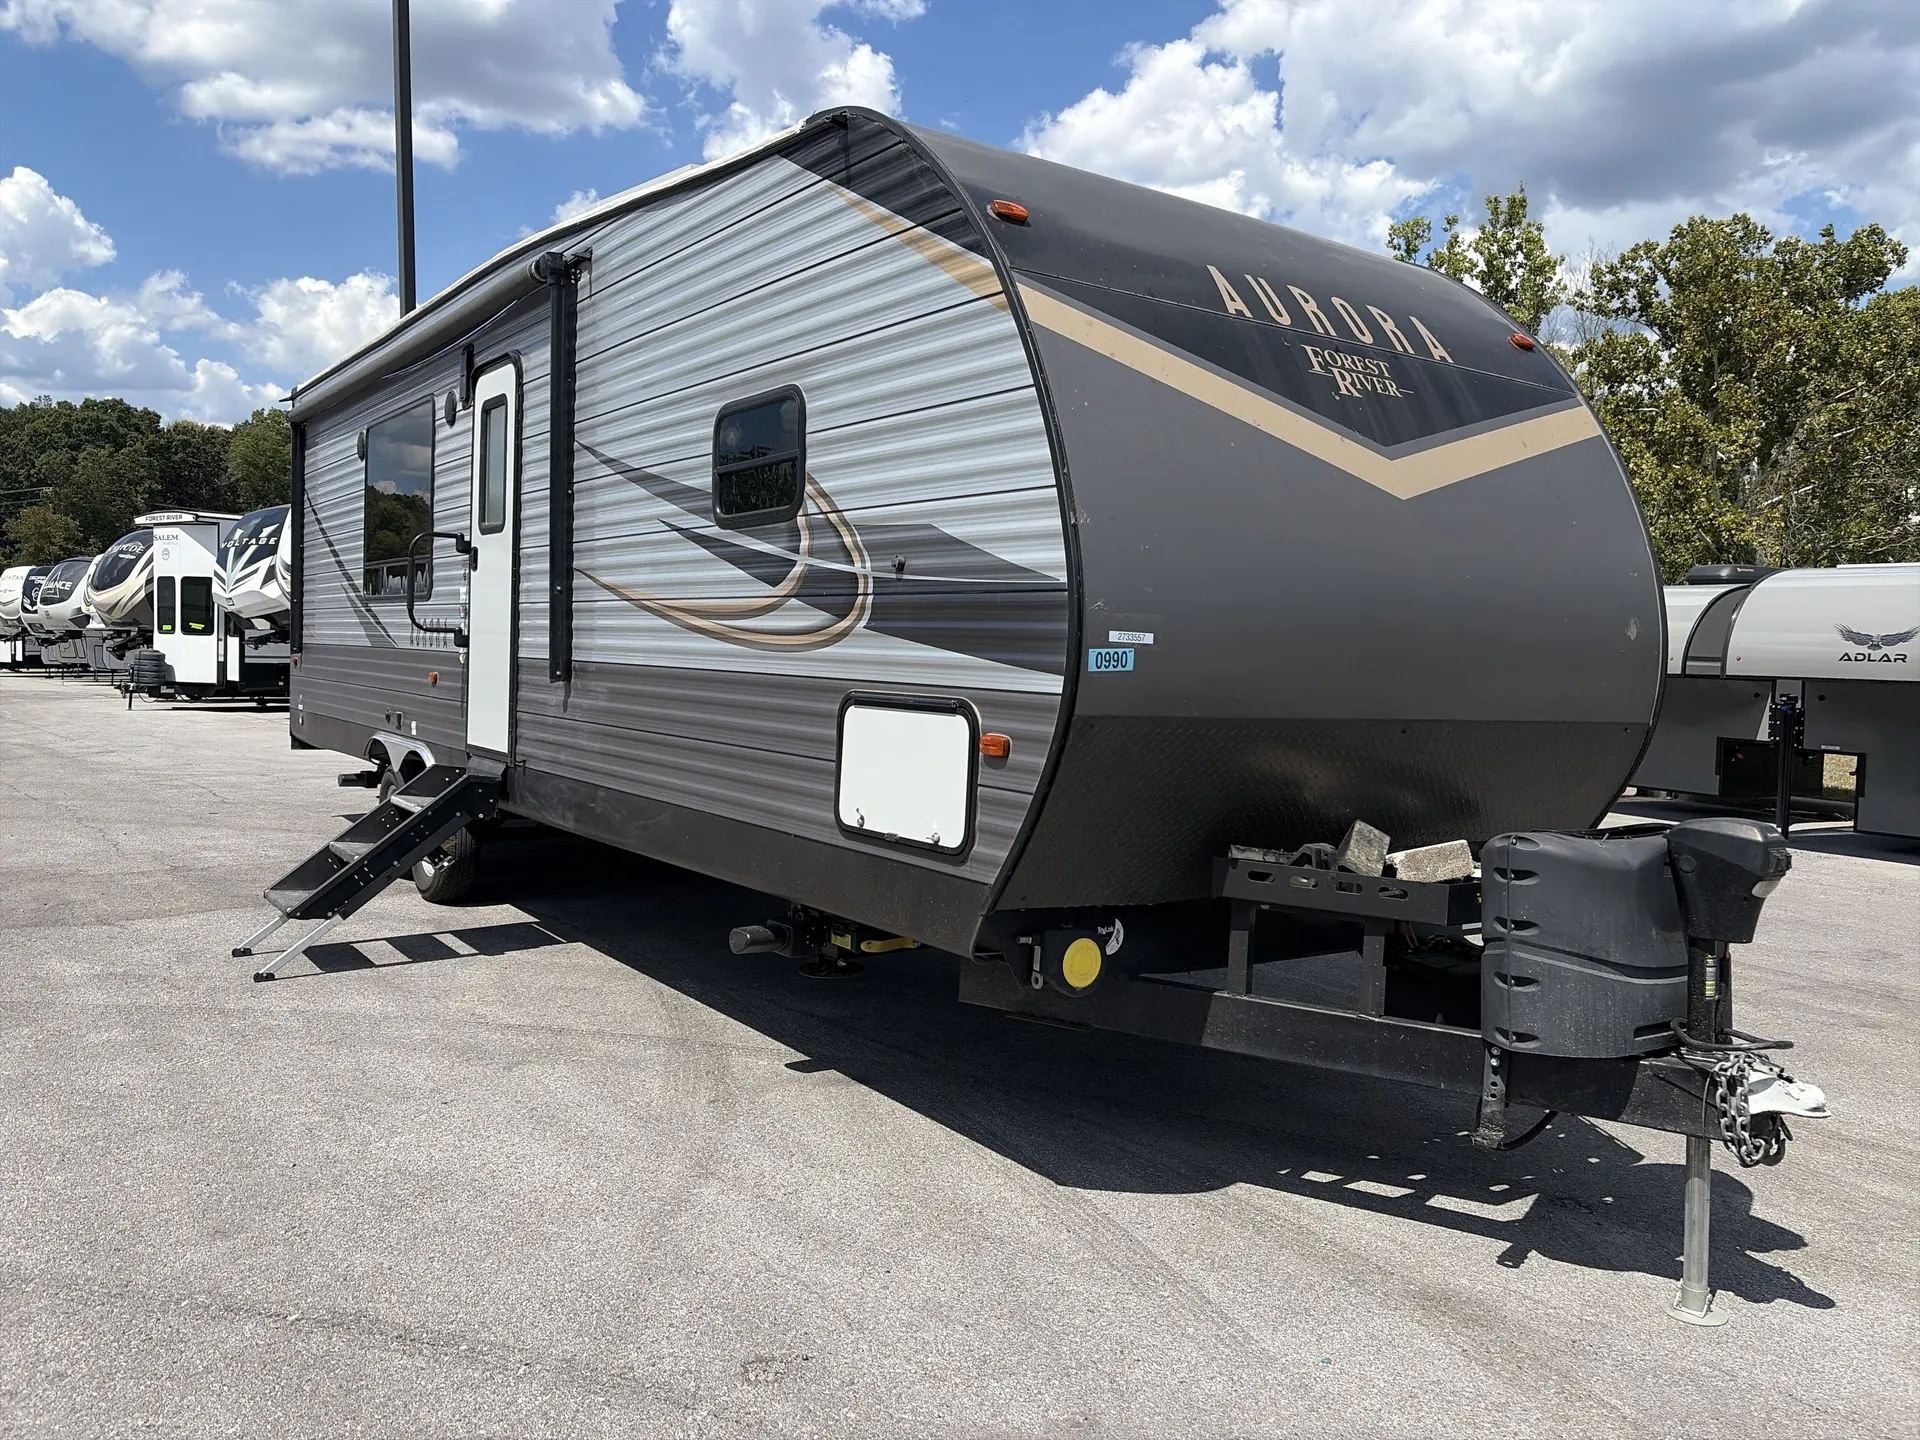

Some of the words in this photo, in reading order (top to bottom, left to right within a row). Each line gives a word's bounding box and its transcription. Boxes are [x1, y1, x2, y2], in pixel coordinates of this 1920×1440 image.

[1206, 264, 1455, 364] AURORA
[1301, 344, 1392, 378] FOREST
[1328, 366, 1403, 398] RIVER
[153, 533, 179, 541] SALEM
[220, 537, 278, 549] VOLTAGE
[1117, 632, 1146, 642] 2733557
[1095, 650, 1128, 670] 0990
[1838, 652, 1908, 663] ADLAR
